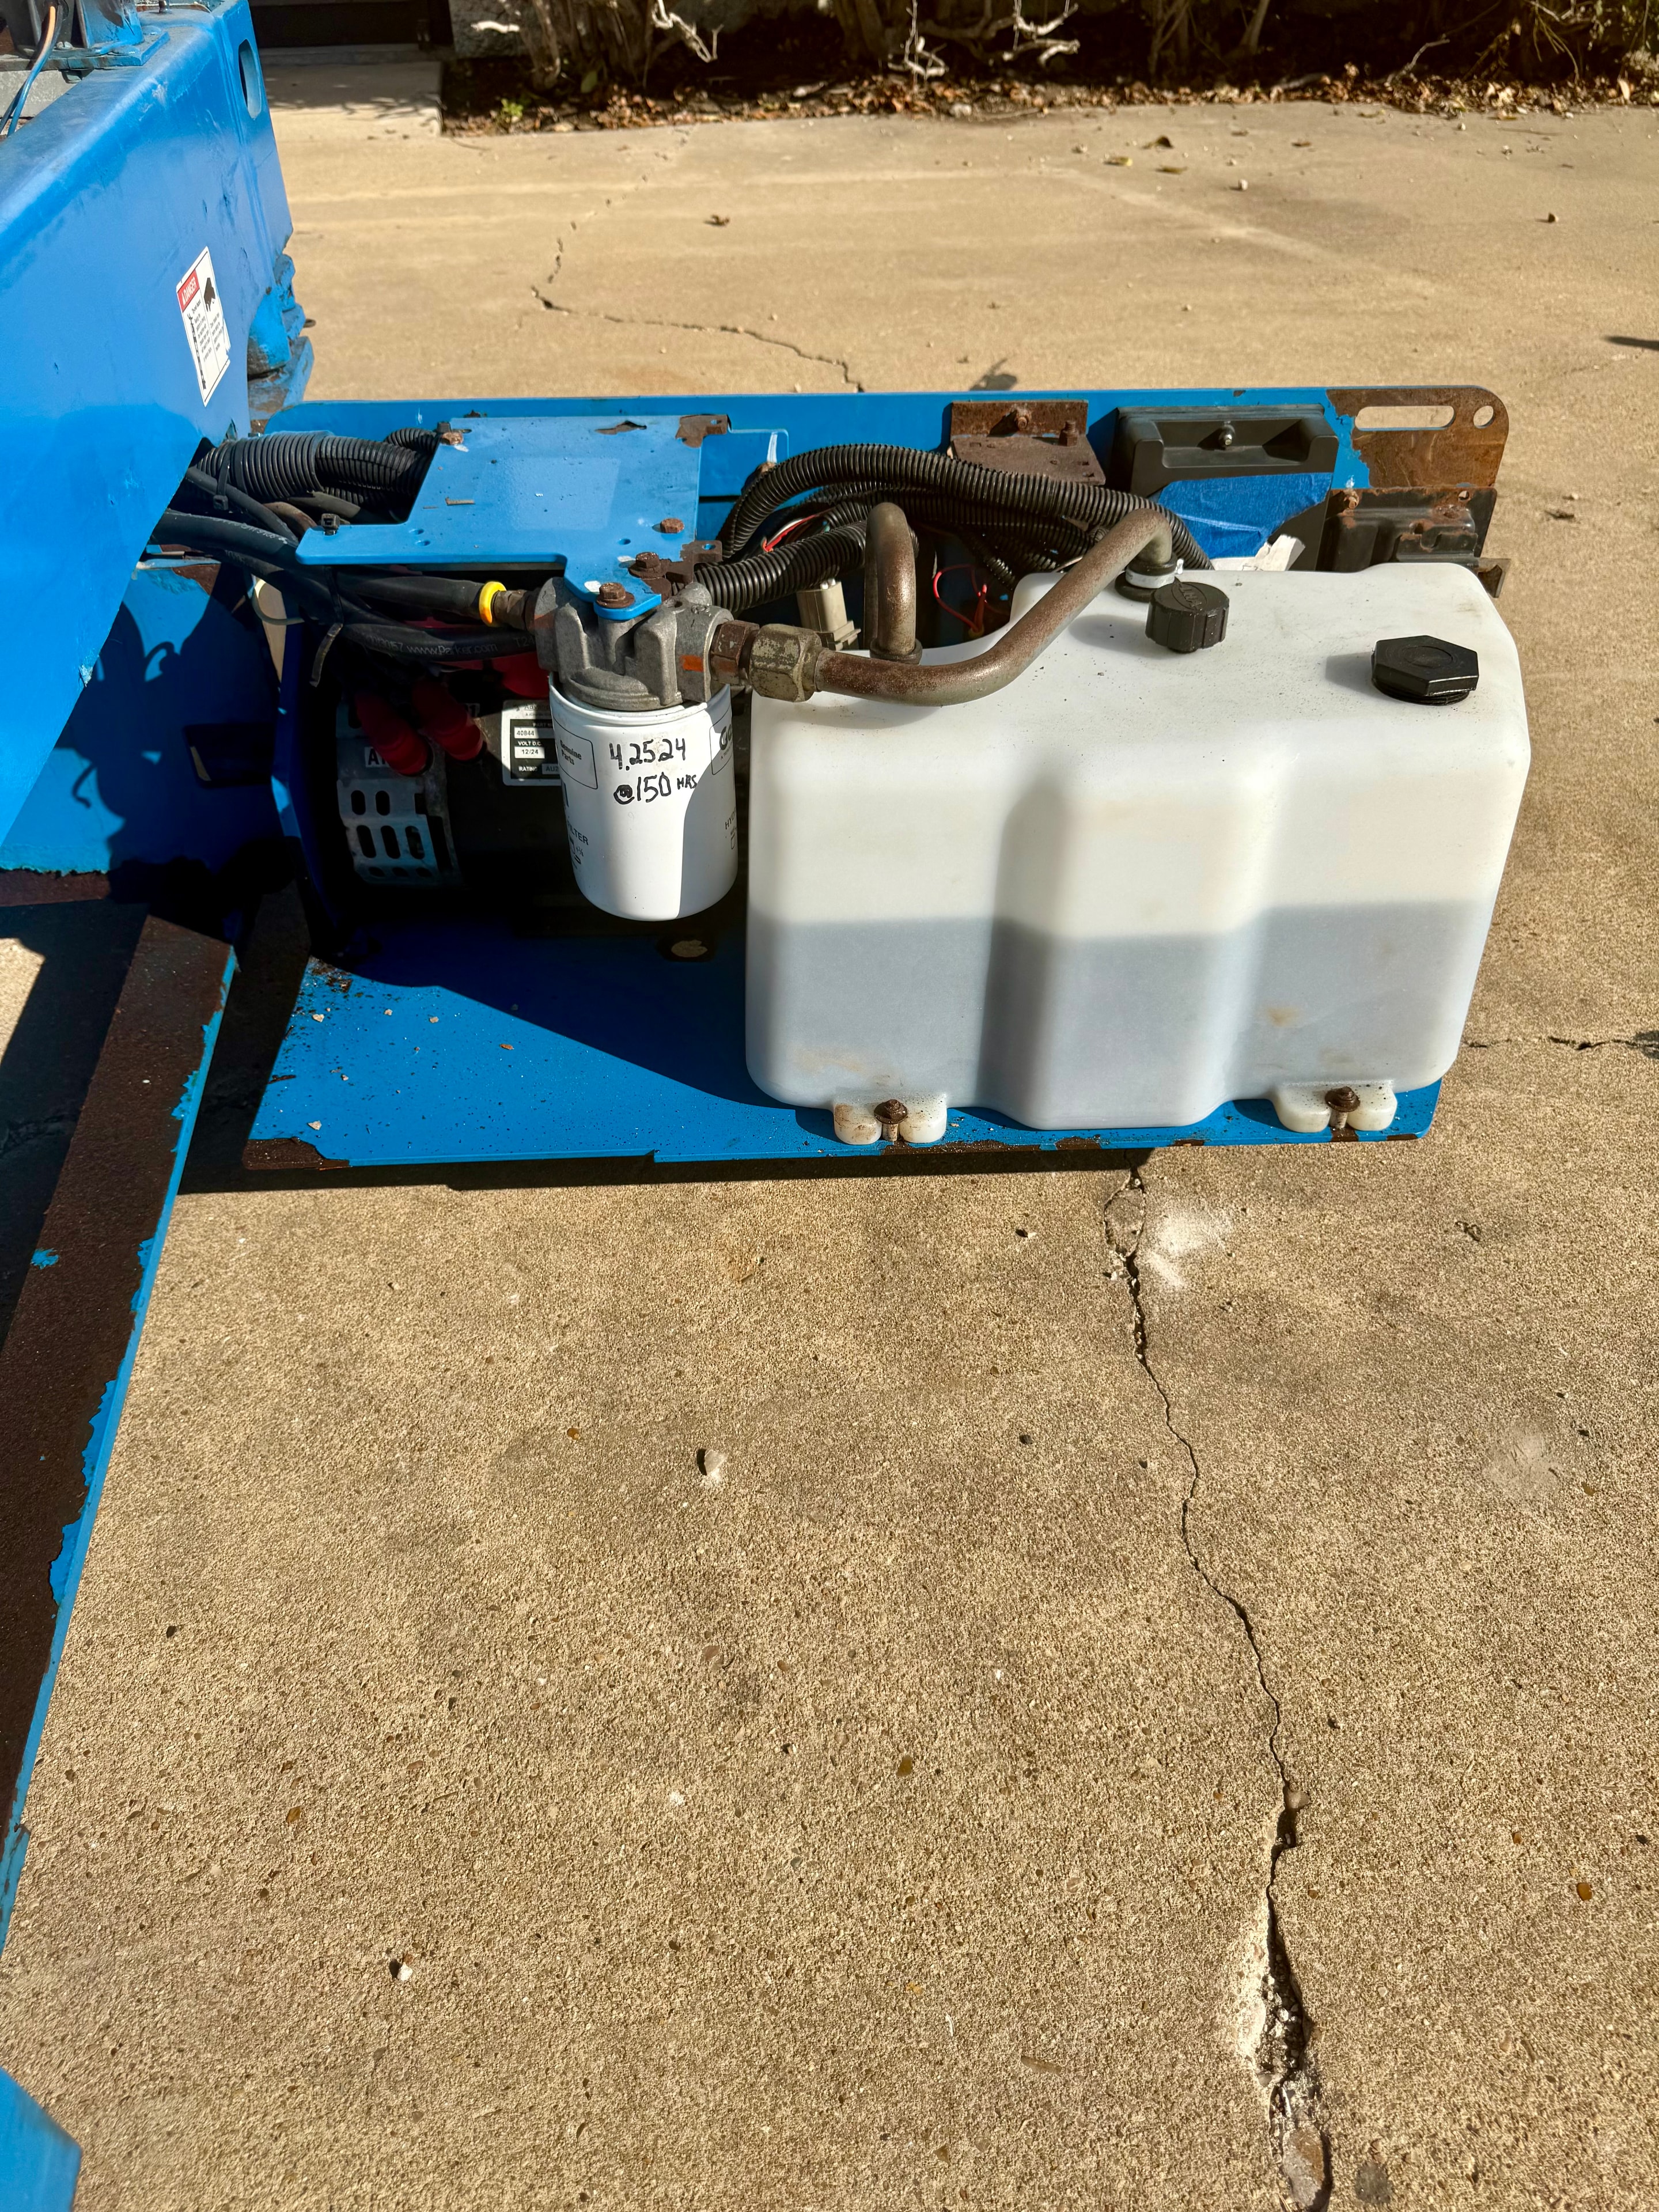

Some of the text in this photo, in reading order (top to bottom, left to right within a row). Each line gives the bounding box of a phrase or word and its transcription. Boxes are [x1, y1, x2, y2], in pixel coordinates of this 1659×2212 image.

[184, 276, 197, 302] DANGER
[406, 642, 498, 656] www.Parker.com
[560, 740, 582, 760] Genuine
[562, 749, 575, 765] Parts
[677, 774, 698, 790] HRS
